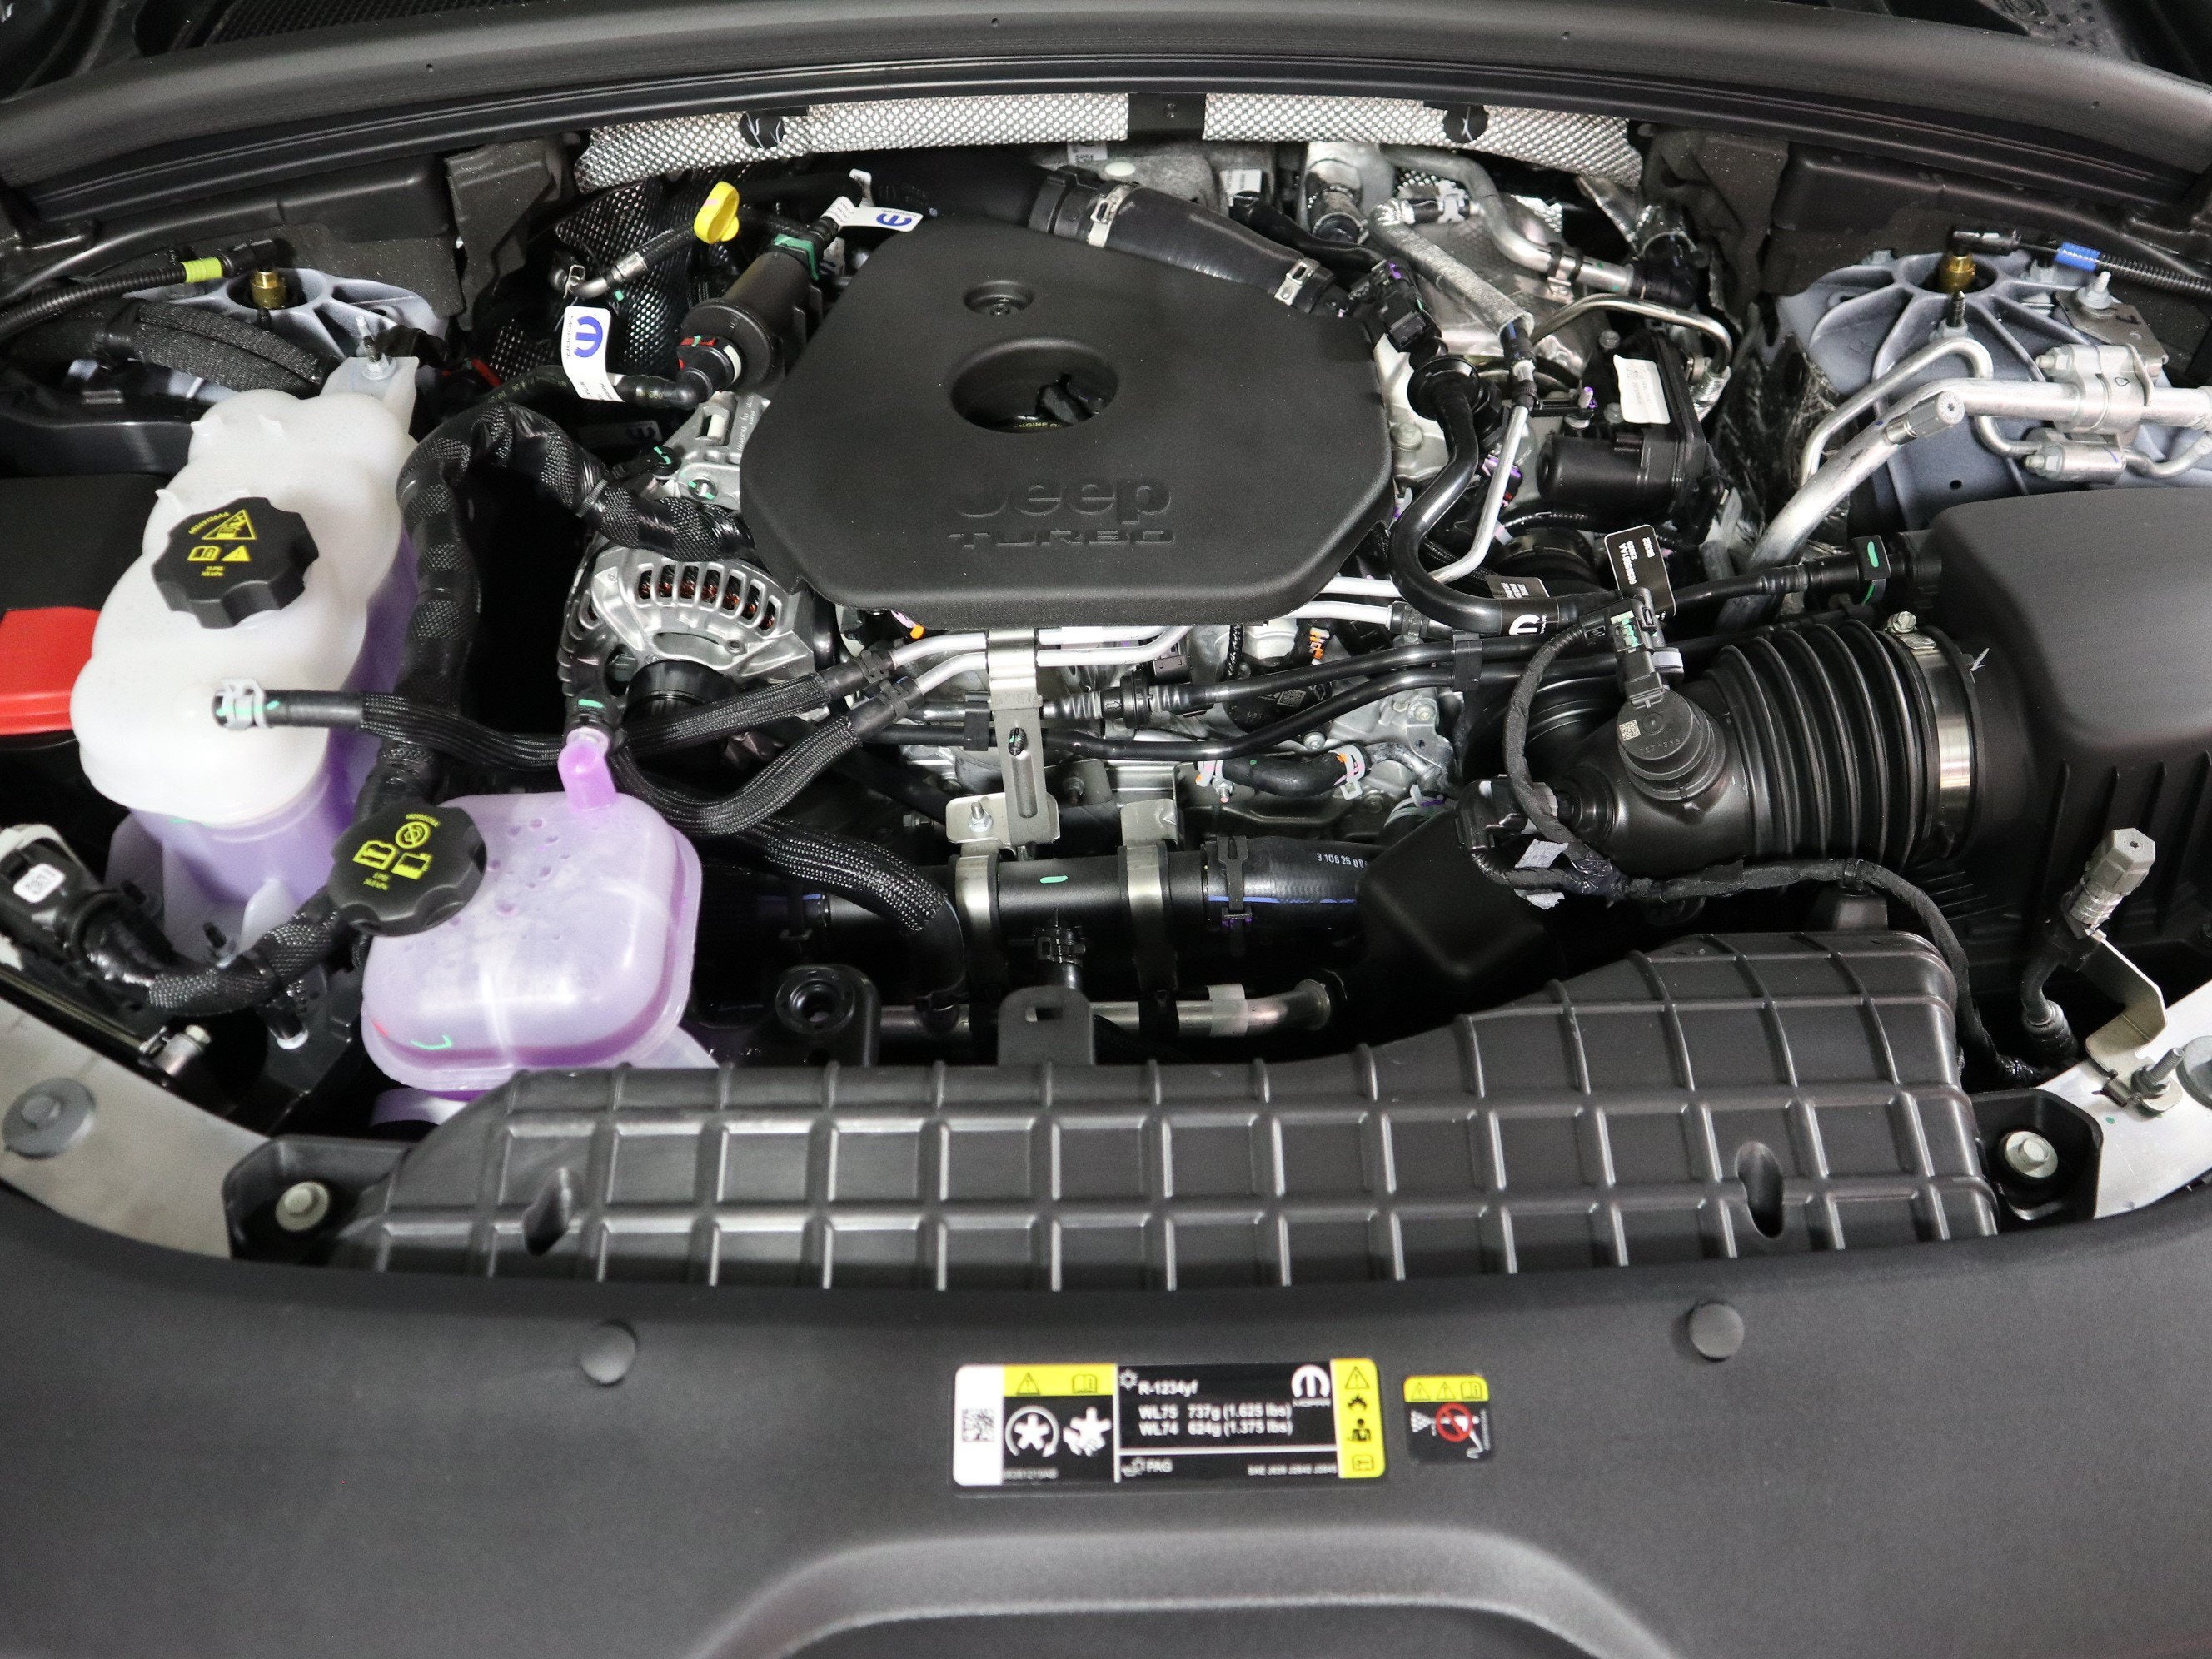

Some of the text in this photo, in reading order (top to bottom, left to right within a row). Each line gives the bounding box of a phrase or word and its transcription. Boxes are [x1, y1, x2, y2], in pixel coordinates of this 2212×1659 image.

[956, 477, 1172, 525] Jeep
[948, 531, 1175, 548] TURBO
[1138, 1379, 1198, 1397] R-1234yf
[1138, 1402, 1293, 1421] WL75 737g (1.625 lbs)
[1138, 1418, 1293, 1437] WL74 624g (1.375 lbs)
